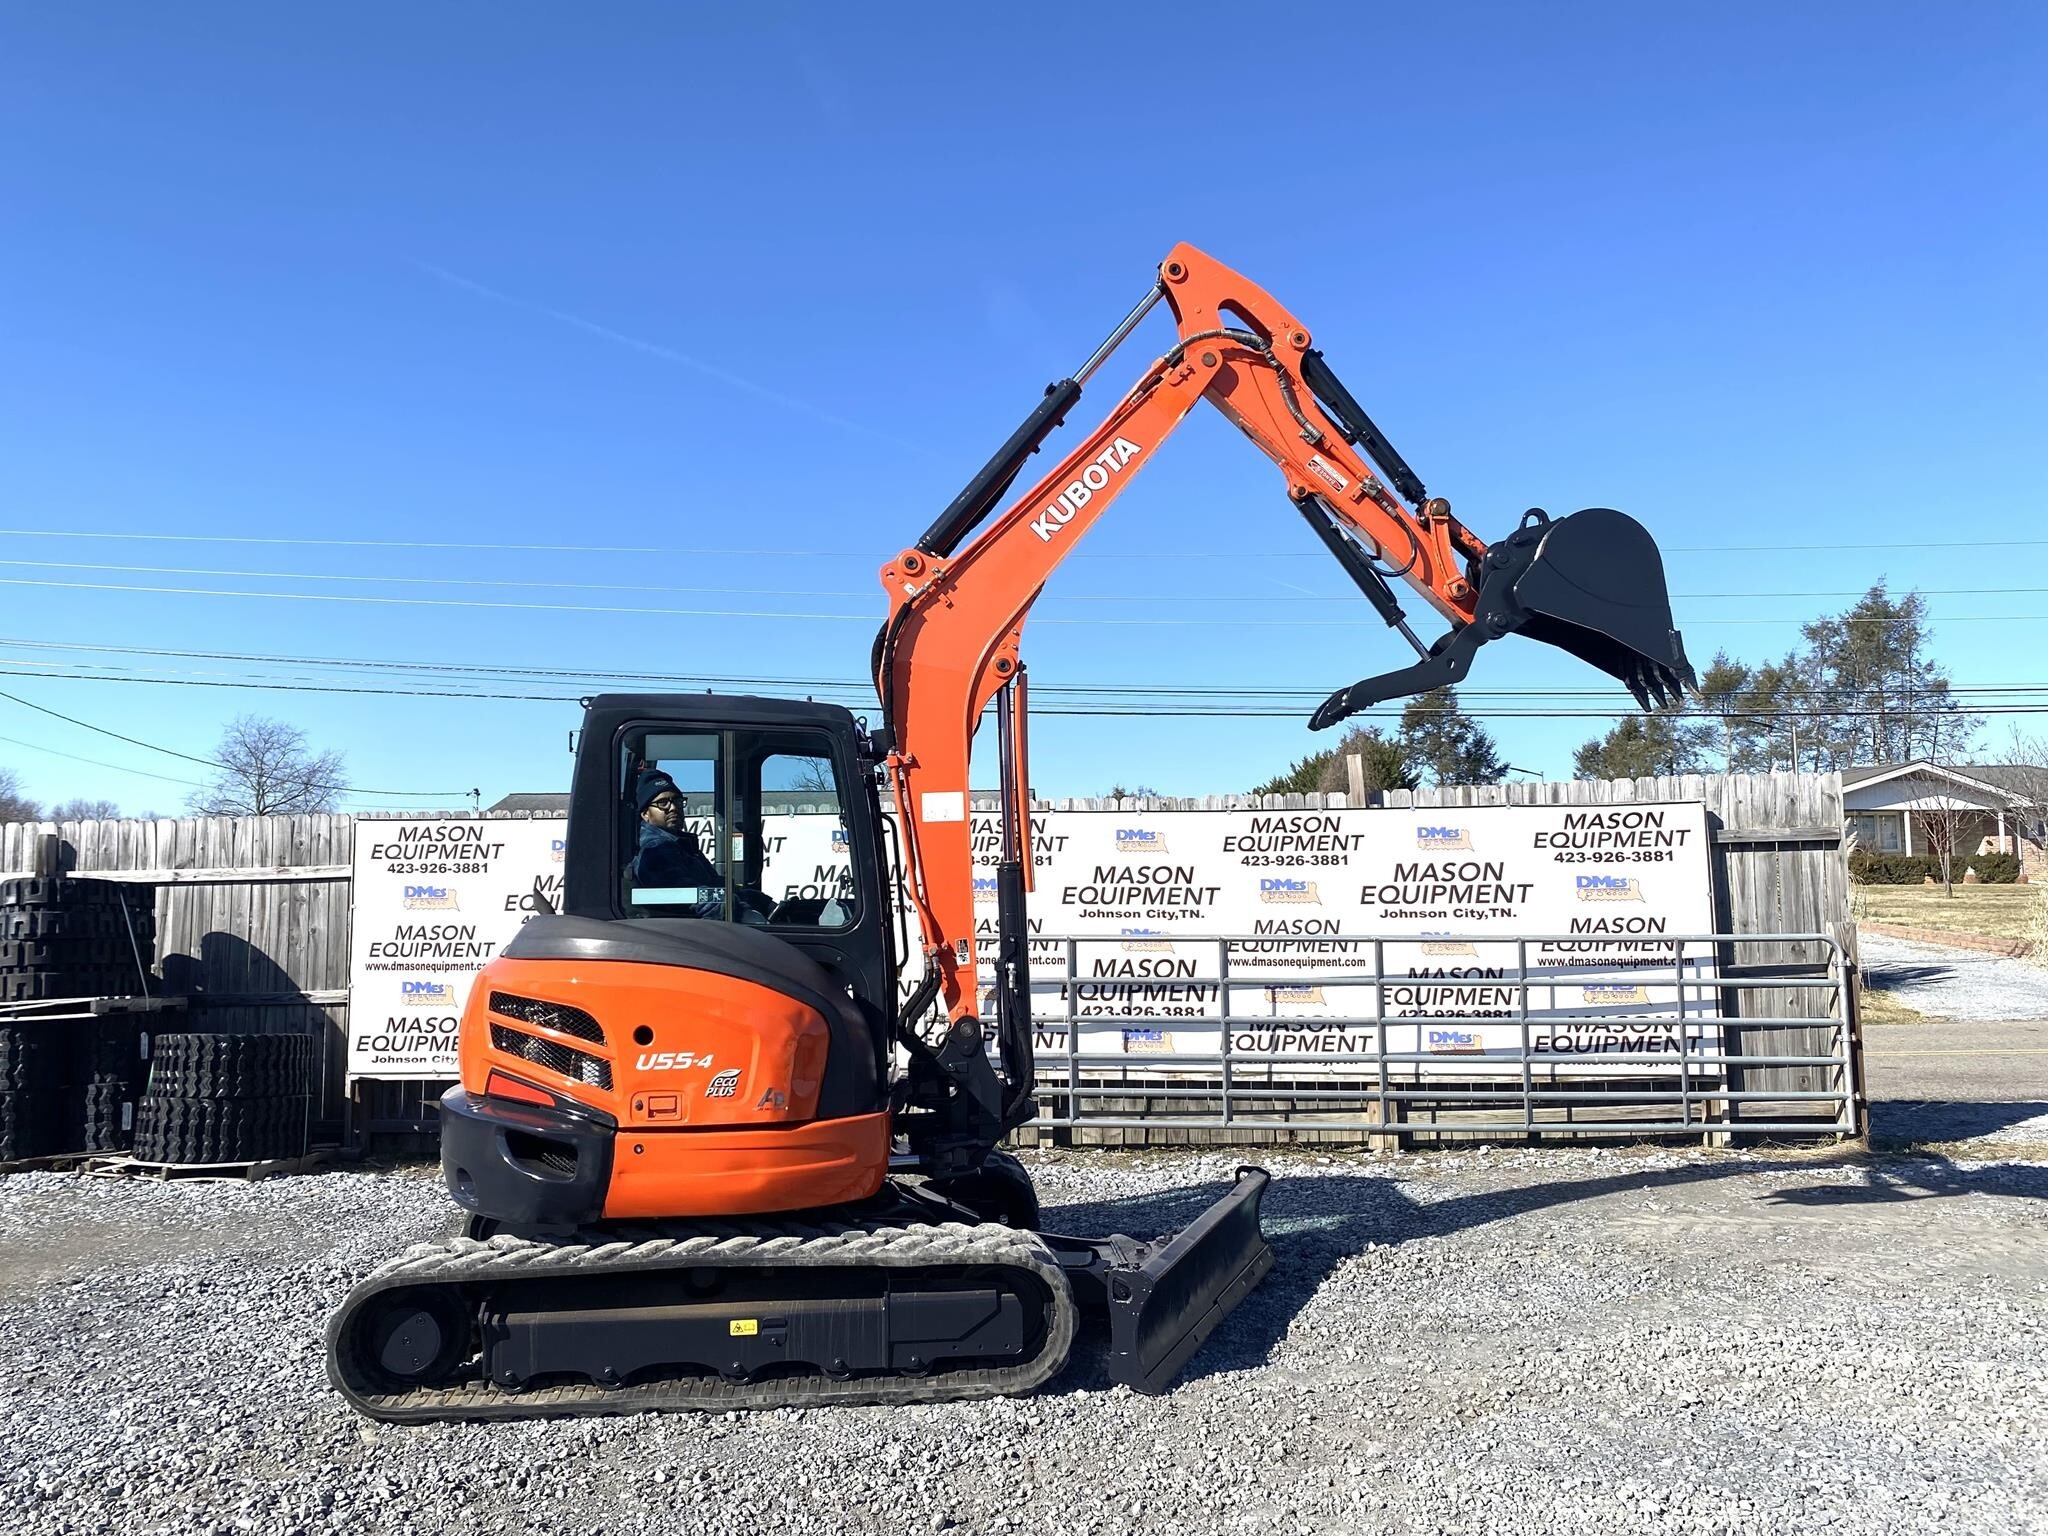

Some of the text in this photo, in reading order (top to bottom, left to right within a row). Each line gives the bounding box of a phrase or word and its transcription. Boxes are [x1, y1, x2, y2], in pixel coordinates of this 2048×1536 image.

[1029, 436, 1143, 543] KUBOTA
[1250, 816, 1341, 834] MASON
[1563, 811, 1665, 830] MASON
[397, 825, 483, 843] MASON
[1533, 829, 1691, 849] EQUIPMENT
[370, 843, 505, 860] EQUIPMENT
[1222, 834, 1365, 853] EQUIPMENT
[1240, 855, 1349, 867] 423-926-3881
[1553, 850, 1674, 863] 423-926-3881
[387, 862, 489, 874] 423-926-3881
[1092, 865, 1195, 885] MASON
[1393, 861, 1504, 883] MASON
[1061, 886, 1221, 906] EQUIPMENT
[1360, 883, 1534, 905] EQUIPMENT
[1079, 909, 1205, 921] Johnson City,TN.
[1379, 908, 1517, 920] Johnson City,TN.
[394, 924, 476, 940] MASON
[1253, 919, 1341, 935] MASON
[1569, 916, 1666, 934] MASON
[368, 942, 496, 958] EQUIPMENT
[365, 961, 487, 973] www.dmasonequipment.c
[1092, 958, 1197, 978] MASON
[1080, 1005, 1205, 1017] 423-926-3881
[385, 1017, 463, 1034] MASO
[356, 1035, 459, 1052] EQUIPME
[1534, 1035, 1703, 1053] EQUIPMENT
[371, 1055, 427, 1064] Johnson
[635, 1052, 715, 1071] U55-4
[714, 1077, 738, 1087] eco
[705, 1086, 736, 1098] PLUS
